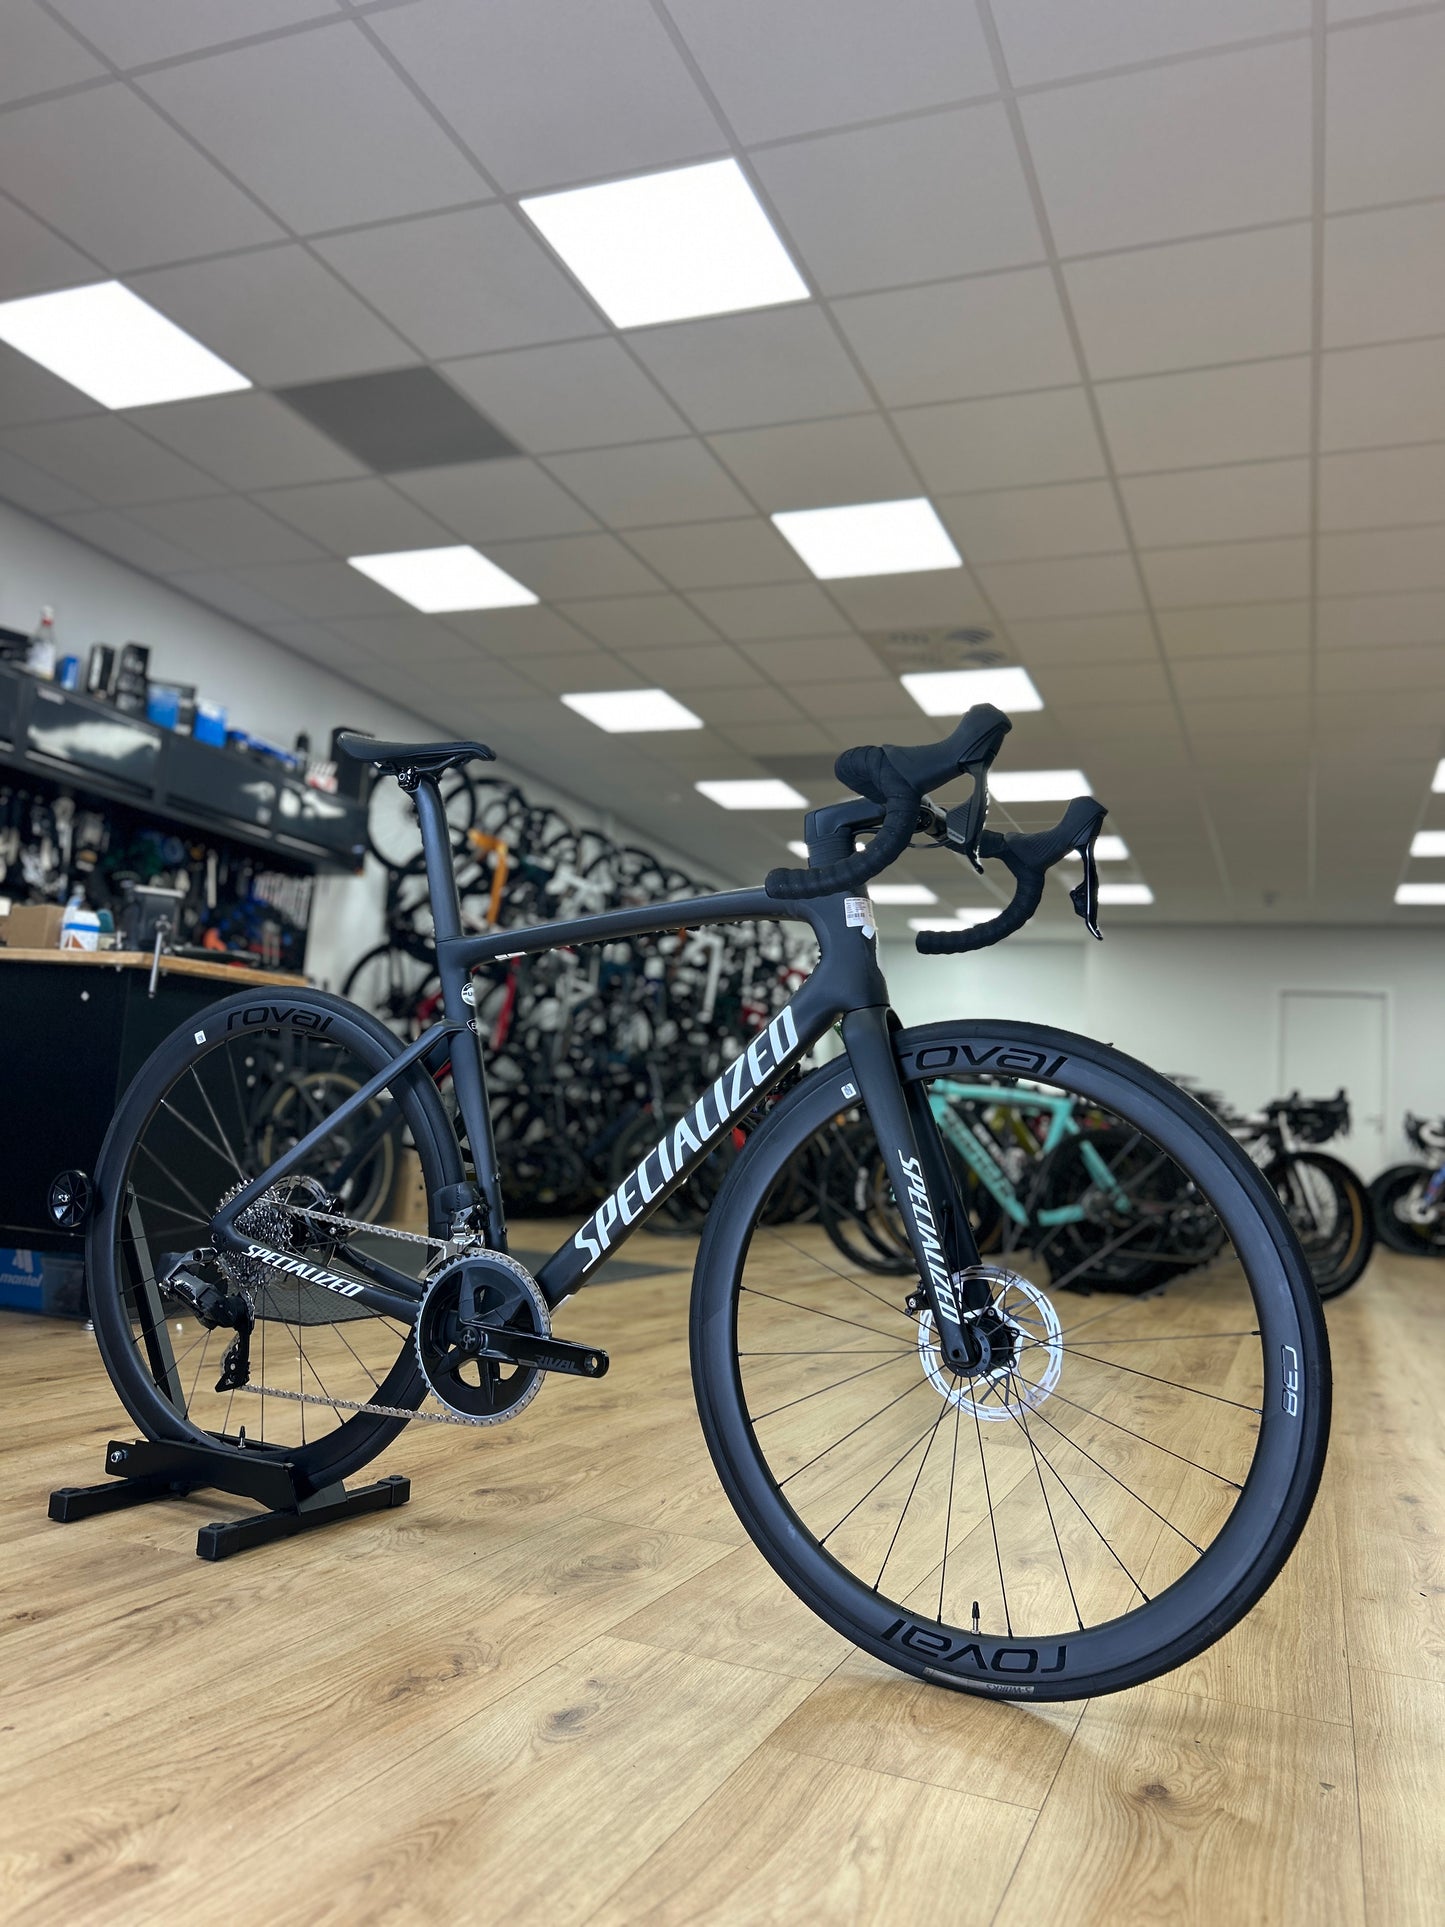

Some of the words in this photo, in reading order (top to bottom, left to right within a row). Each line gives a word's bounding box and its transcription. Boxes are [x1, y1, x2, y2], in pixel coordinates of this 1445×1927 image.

[227, 1007, 334, 1032] roval
[574, 1004, 799, 1273] SPECIALIZED
[898, 1149, 961, 1325] SPECIALIZED
[241, 1244, 365, 1297] SPECIALIZED
[535, 1354, 577, 1371] RIVAL
[1281, 1344, 1298, 1417] C38
[880, 1618, 1067, 1674] roval
